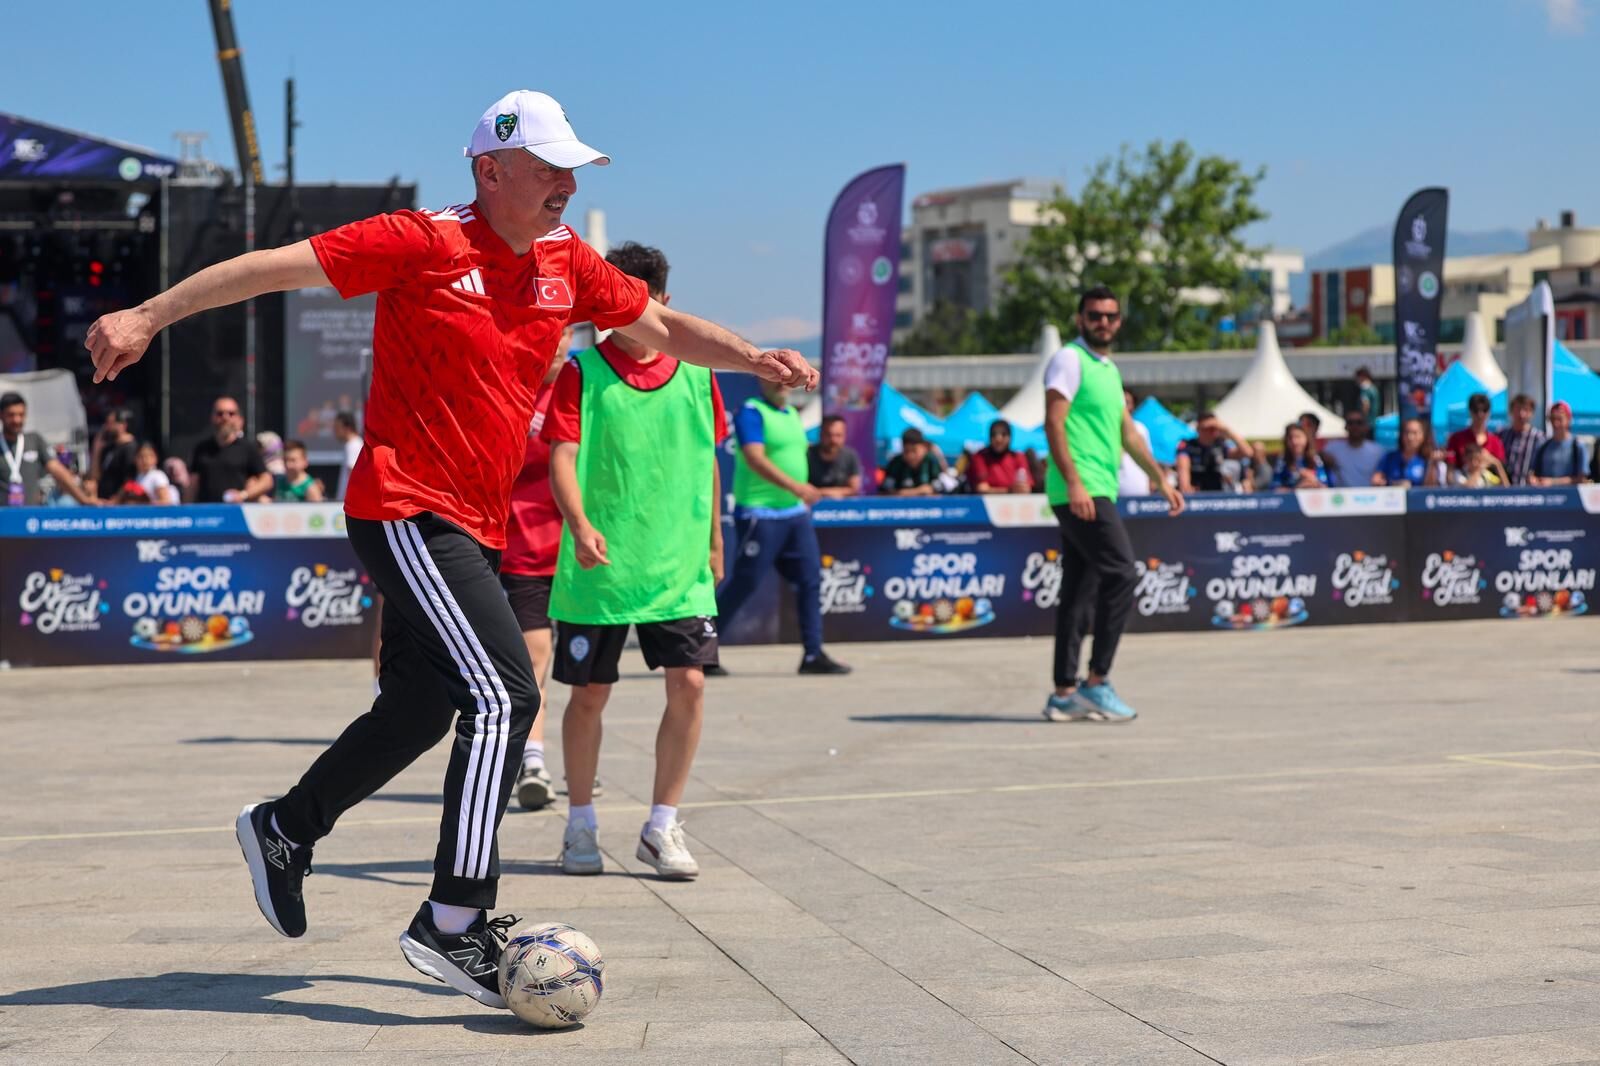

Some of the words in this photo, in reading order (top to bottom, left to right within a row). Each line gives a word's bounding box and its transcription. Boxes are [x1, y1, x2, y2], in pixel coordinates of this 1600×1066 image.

[912, 553, 977, 576] SPOR
[1231, 554, 1290, 578] SPOR
[1518, 549, 1572, 571] SPOR
[155, 566, 232, 590] SPOR
[884, 573, 1006, 600] OYUNLARI
[1206, 574, 1317, 601] OYUNLARI
[1495, 569, 1596, 592] OYUNLARI
[123, 590, 265, 617] OYUNLARI
